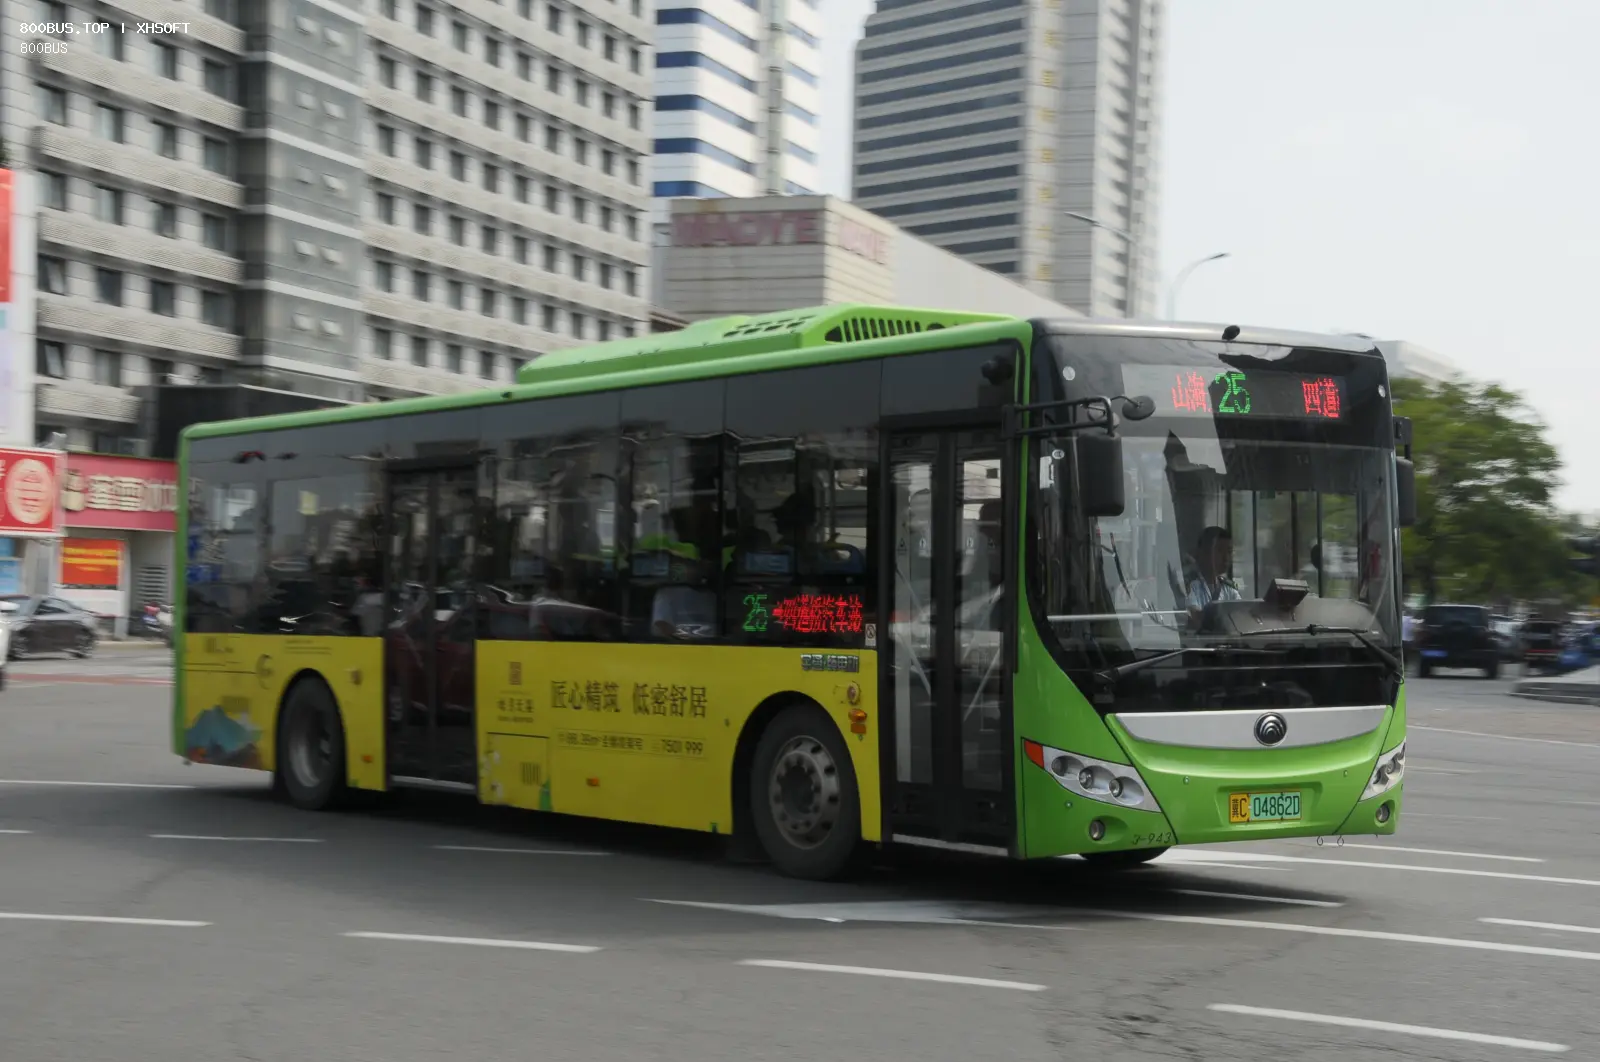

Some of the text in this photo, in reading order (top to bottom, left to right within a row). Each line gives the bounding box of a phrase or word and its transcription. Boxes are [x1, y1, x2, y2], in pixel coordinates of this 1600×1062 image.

[1214, 372, 1252, 414] 25
[1302, 377, 1340, 419] 四道
[742, 594, 769, 632] 25
[550, 680, 621, 713] 匠心精筑
[633, 682, 708, 718] 低密舒居
[1253, 795, 1300, 817] 04862D
